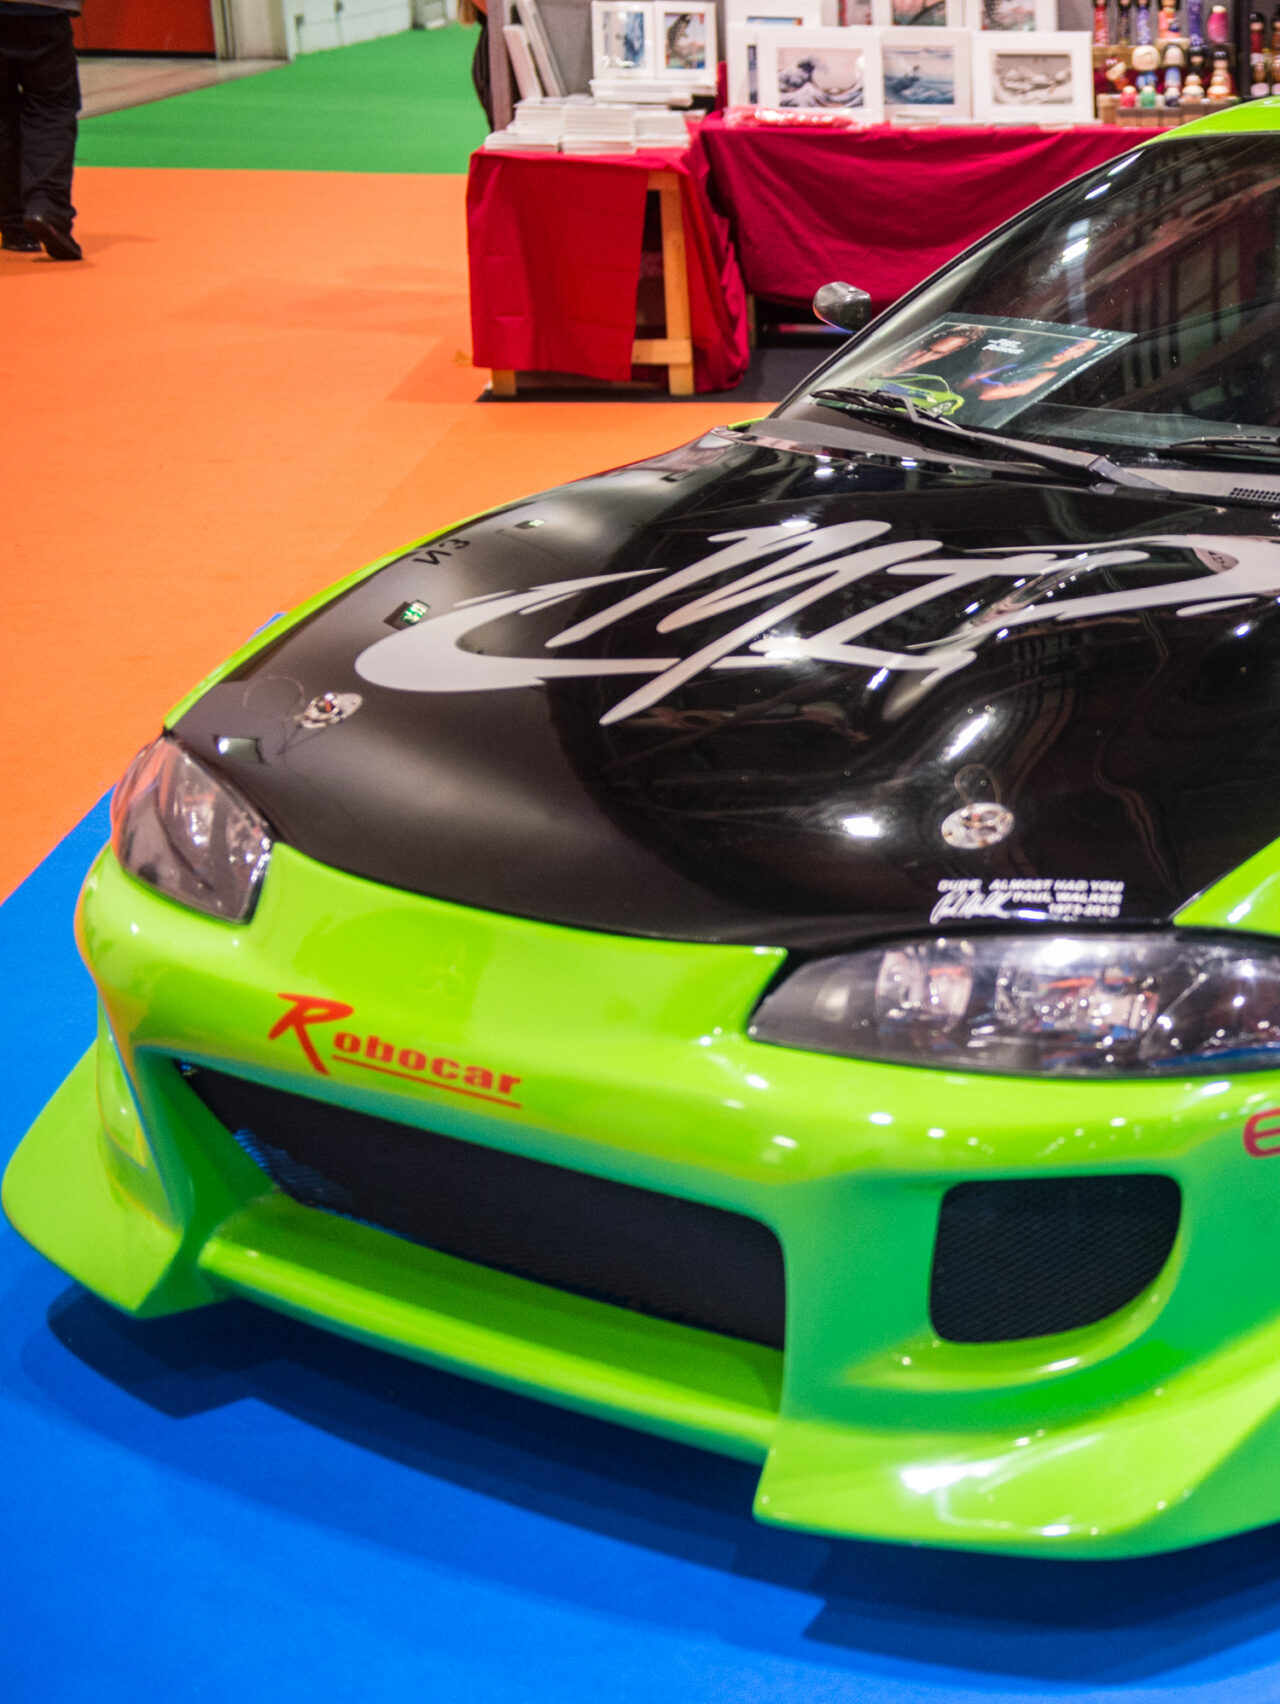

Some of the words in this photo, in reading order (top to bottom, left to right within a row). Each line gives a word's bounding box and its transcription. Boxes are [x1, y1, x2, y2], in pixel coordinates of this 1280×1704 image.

[988, 879, 1055, 892] ALMOST
[1053, 879, 1089, 892] HAD
[1089, 881, 1125, 893] YOU
[1055, 891, 1123, 905] WALKER
[268, 992, 523, 1096] Robocar
